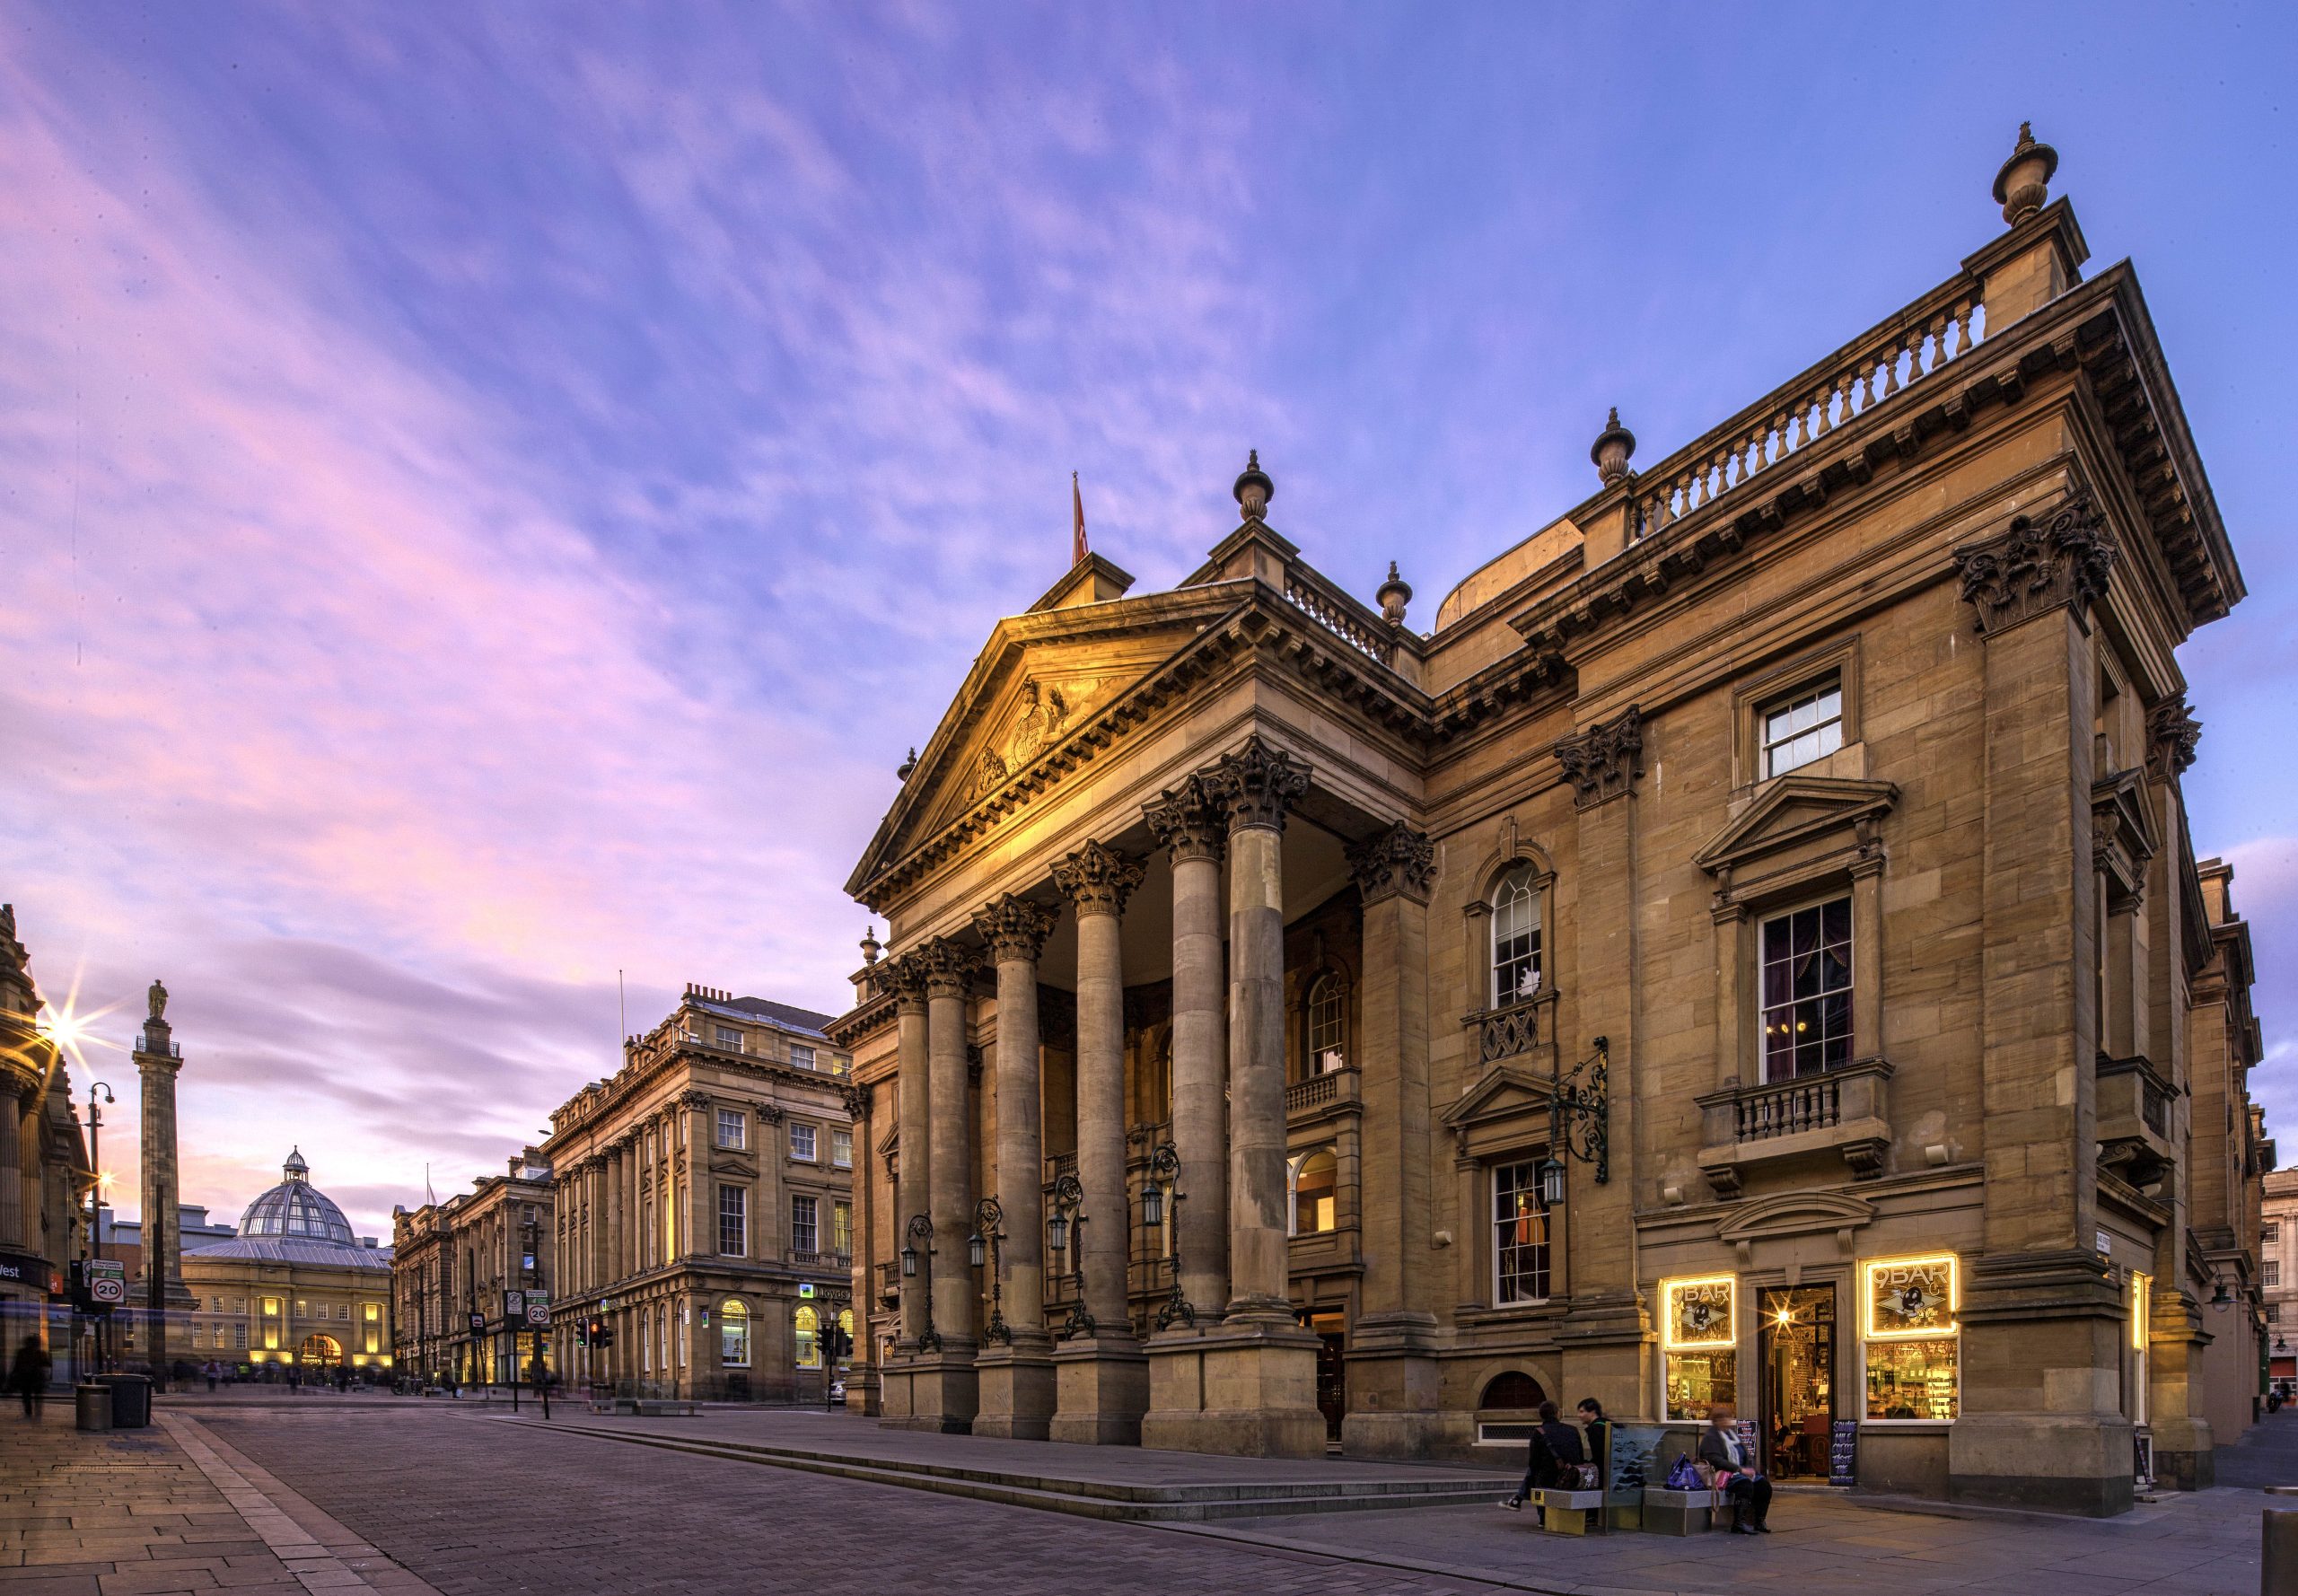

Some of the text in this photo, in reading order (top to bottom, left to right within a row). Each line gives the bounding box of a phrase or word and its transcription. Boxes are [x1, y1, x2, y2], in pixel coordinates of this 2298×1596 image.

[1873, 1263, 1948, 1288] 9BAR
[99, 1285, 118, 1295] 20
[817, 1287, 846, 1300] Lloyds
[1671, 1283, 1730, 1305] 9BAR
[531, 1310, 546, 1319] 20
[1883, 1321, 1938, 1330] COFFEE
[1835, 1433, 1852, 1443] MILE
[1832, 1443, 1855, 1454] COFFEE
